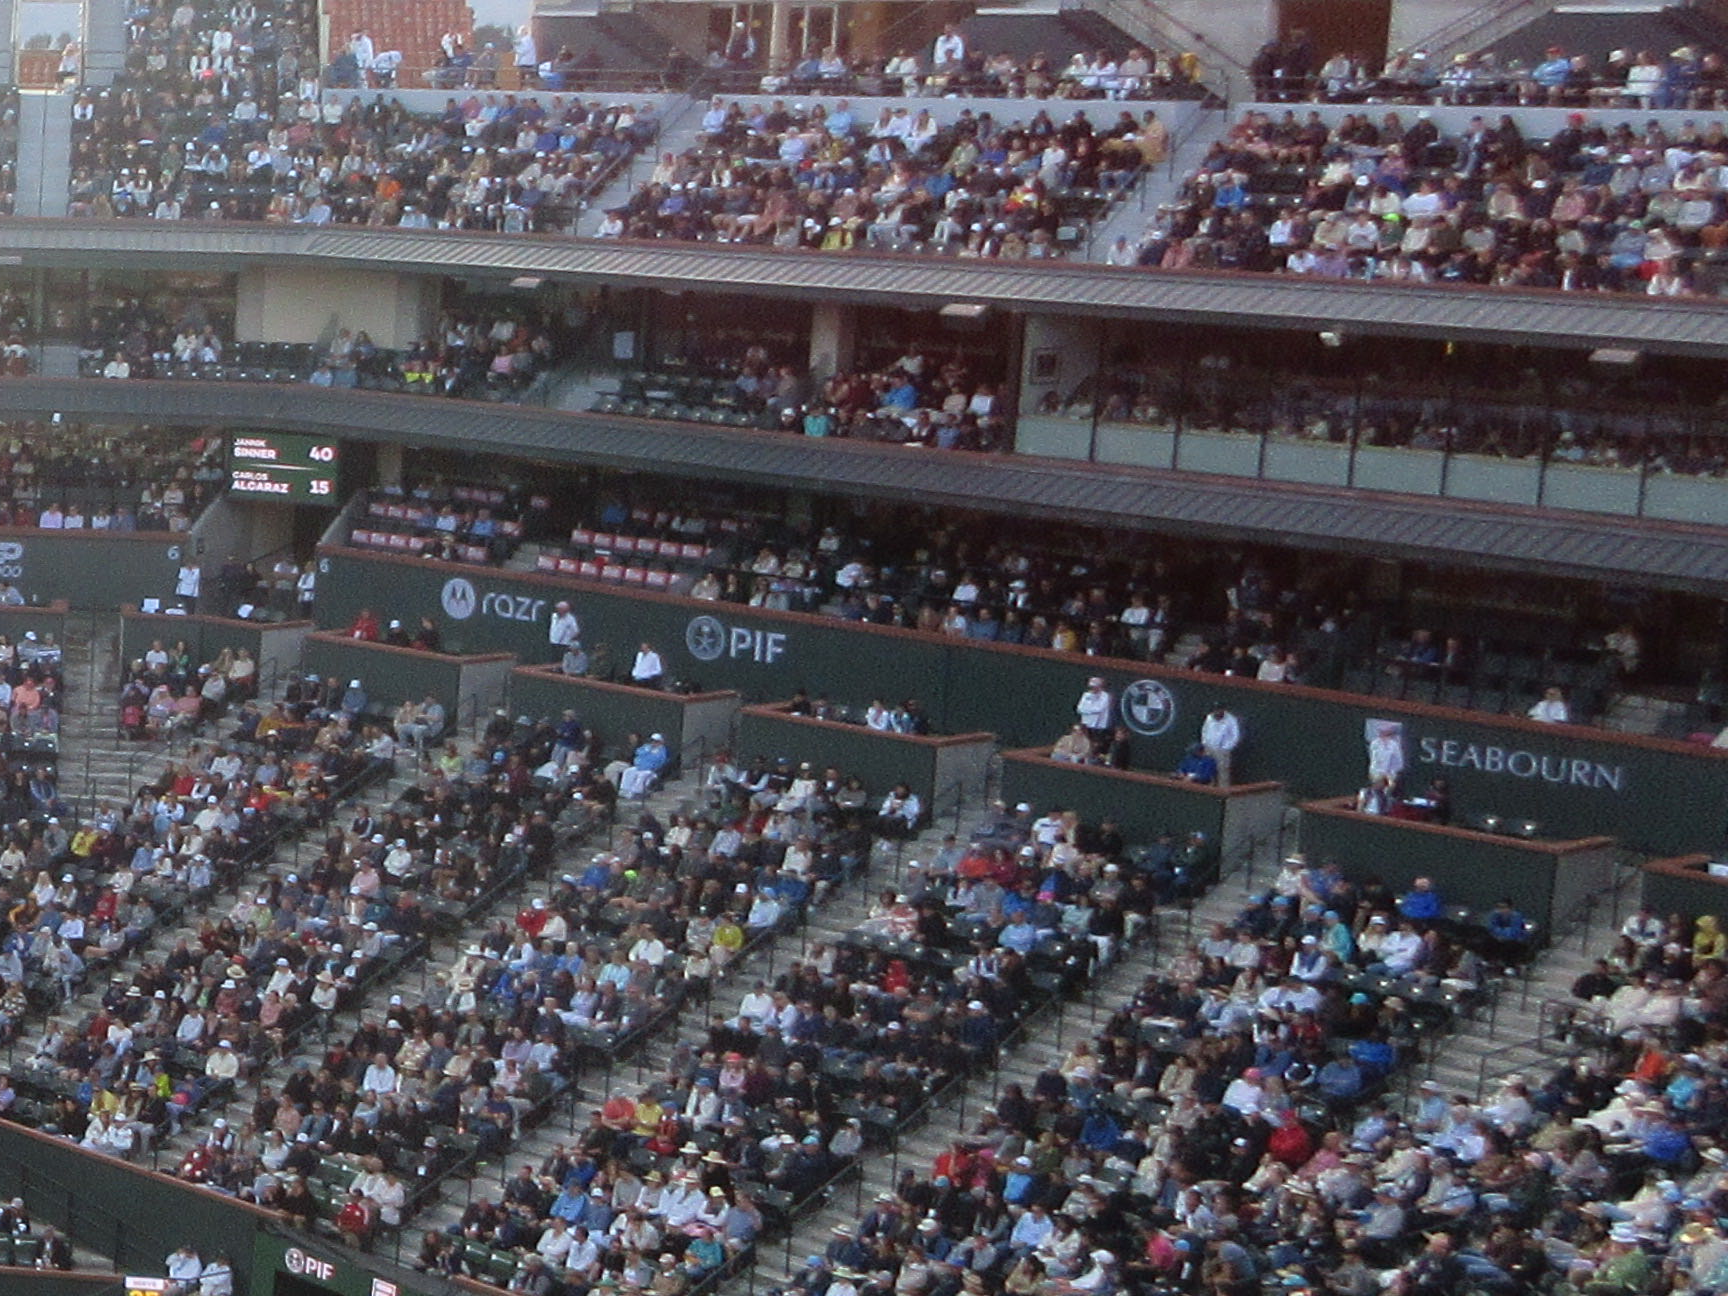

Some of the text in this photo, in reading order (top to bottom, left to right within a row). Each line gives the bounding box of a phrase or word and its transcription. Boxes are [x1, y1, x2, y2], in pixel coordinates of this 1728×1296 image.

[233, 447, 277, 460] SINNER
[309, 446, 334, 462] 40
[232, 471, 269, 481] CARLOS
[231, 480, 330, 495] ALCARAZ 15
[168, 546, 180, 561] 6
[482, 592, 545, 623] razr
[729, 626, 787, 664] PIF
[1419, 736, 1622, 792] SEABOURN
[305, 1257, 335, 1281] PIF
